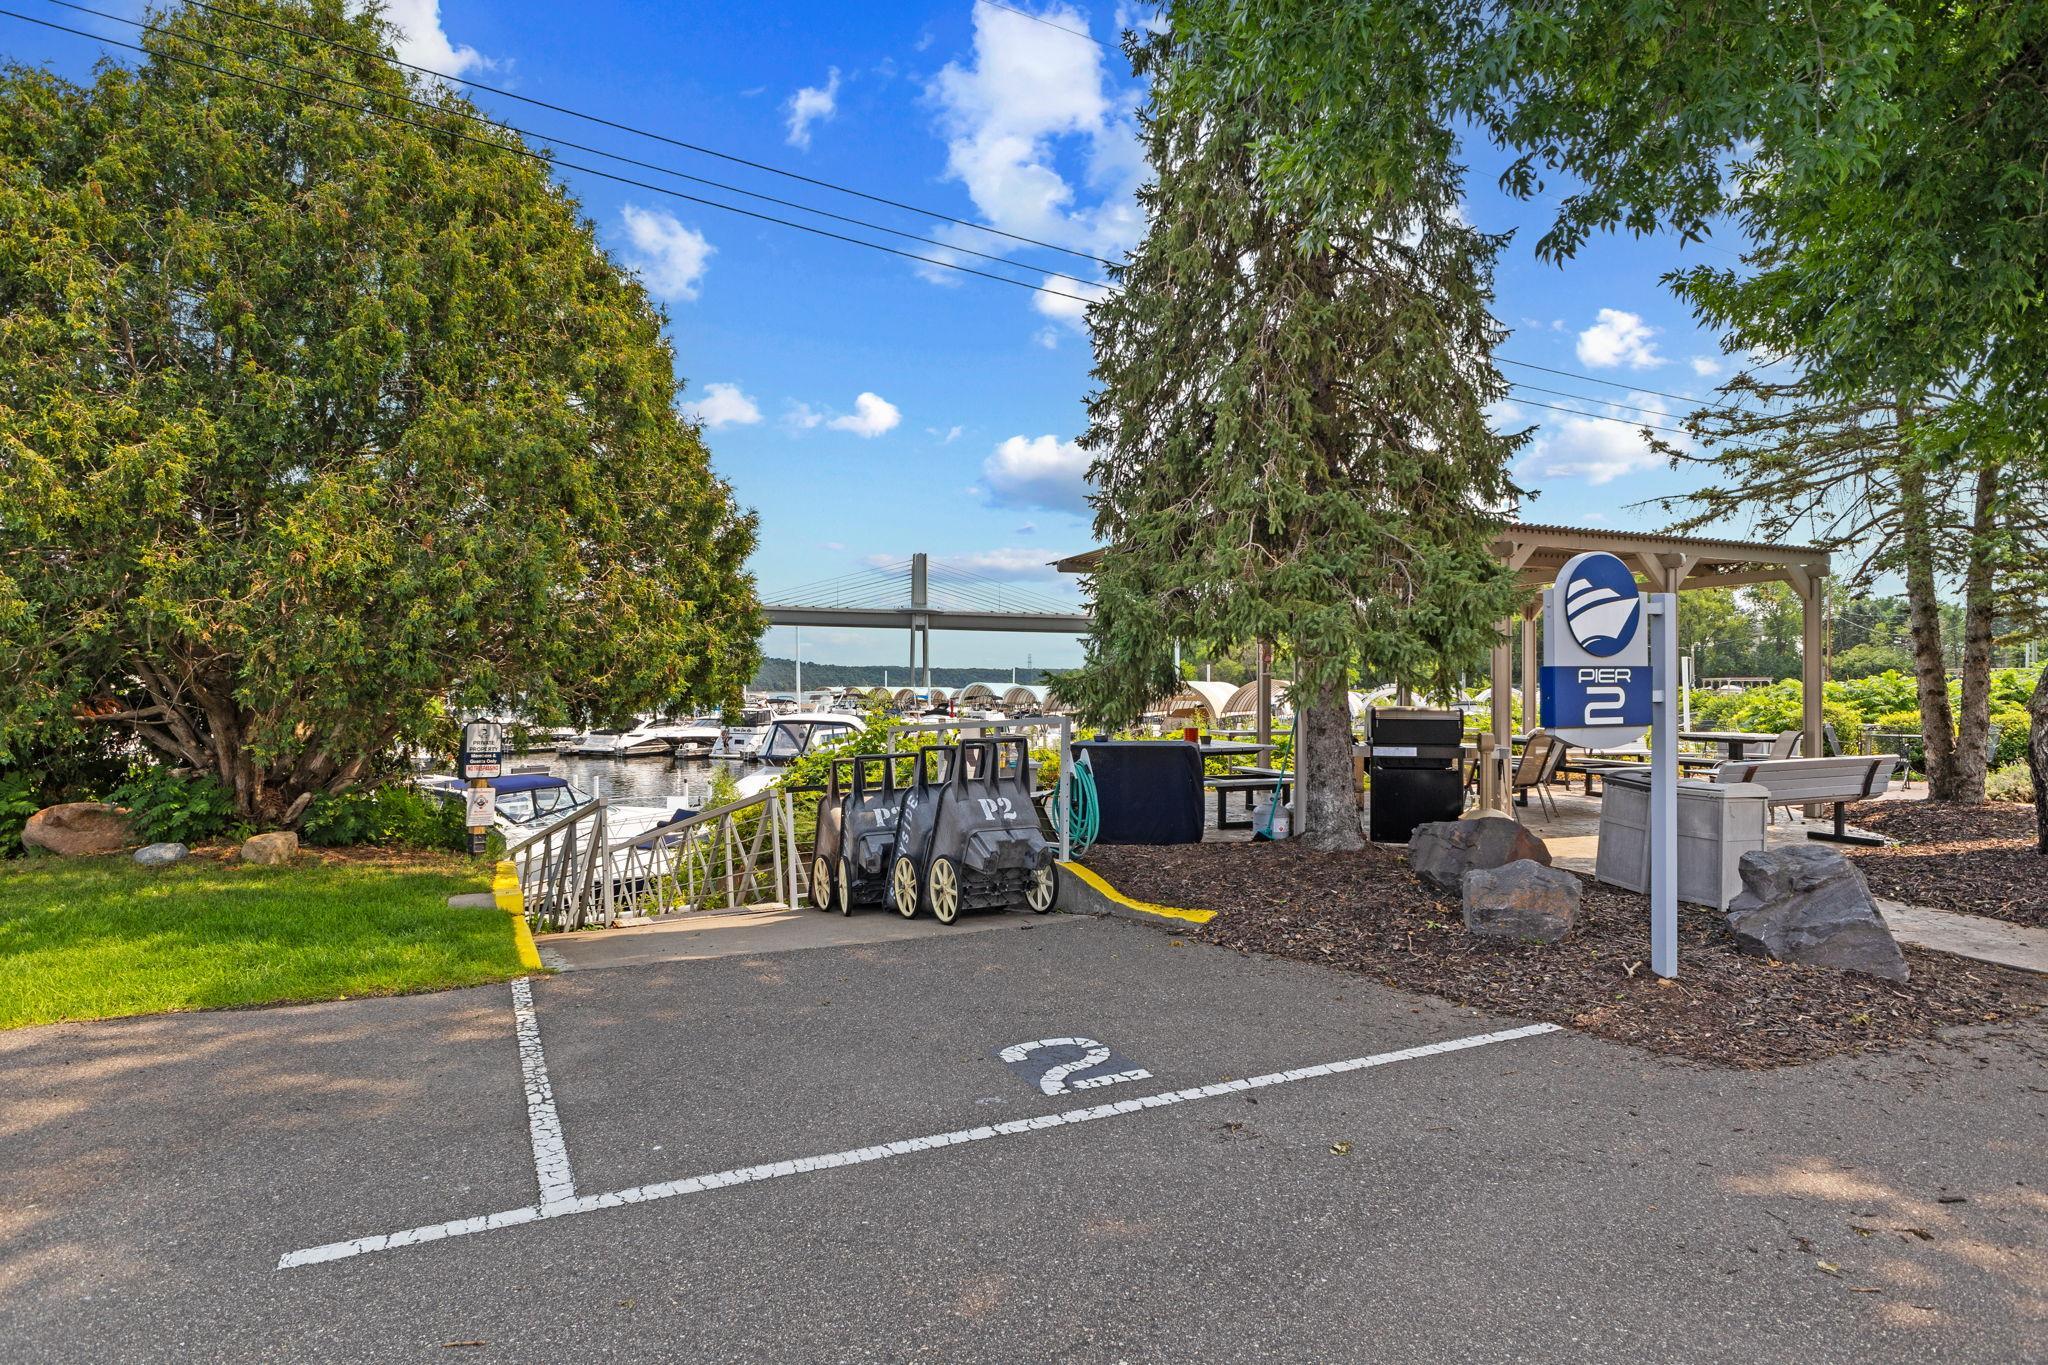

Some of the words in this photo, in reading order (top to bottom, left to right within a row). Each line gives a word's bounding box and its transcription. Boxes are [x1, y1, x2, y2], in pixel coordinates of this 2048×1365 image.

[1578, 668, 1632, 684] PIER
[1584, 686, 1626, 725] 2
[977, 797, 1018, 821] P2
[999, 1037, 1154, 1096] 2
